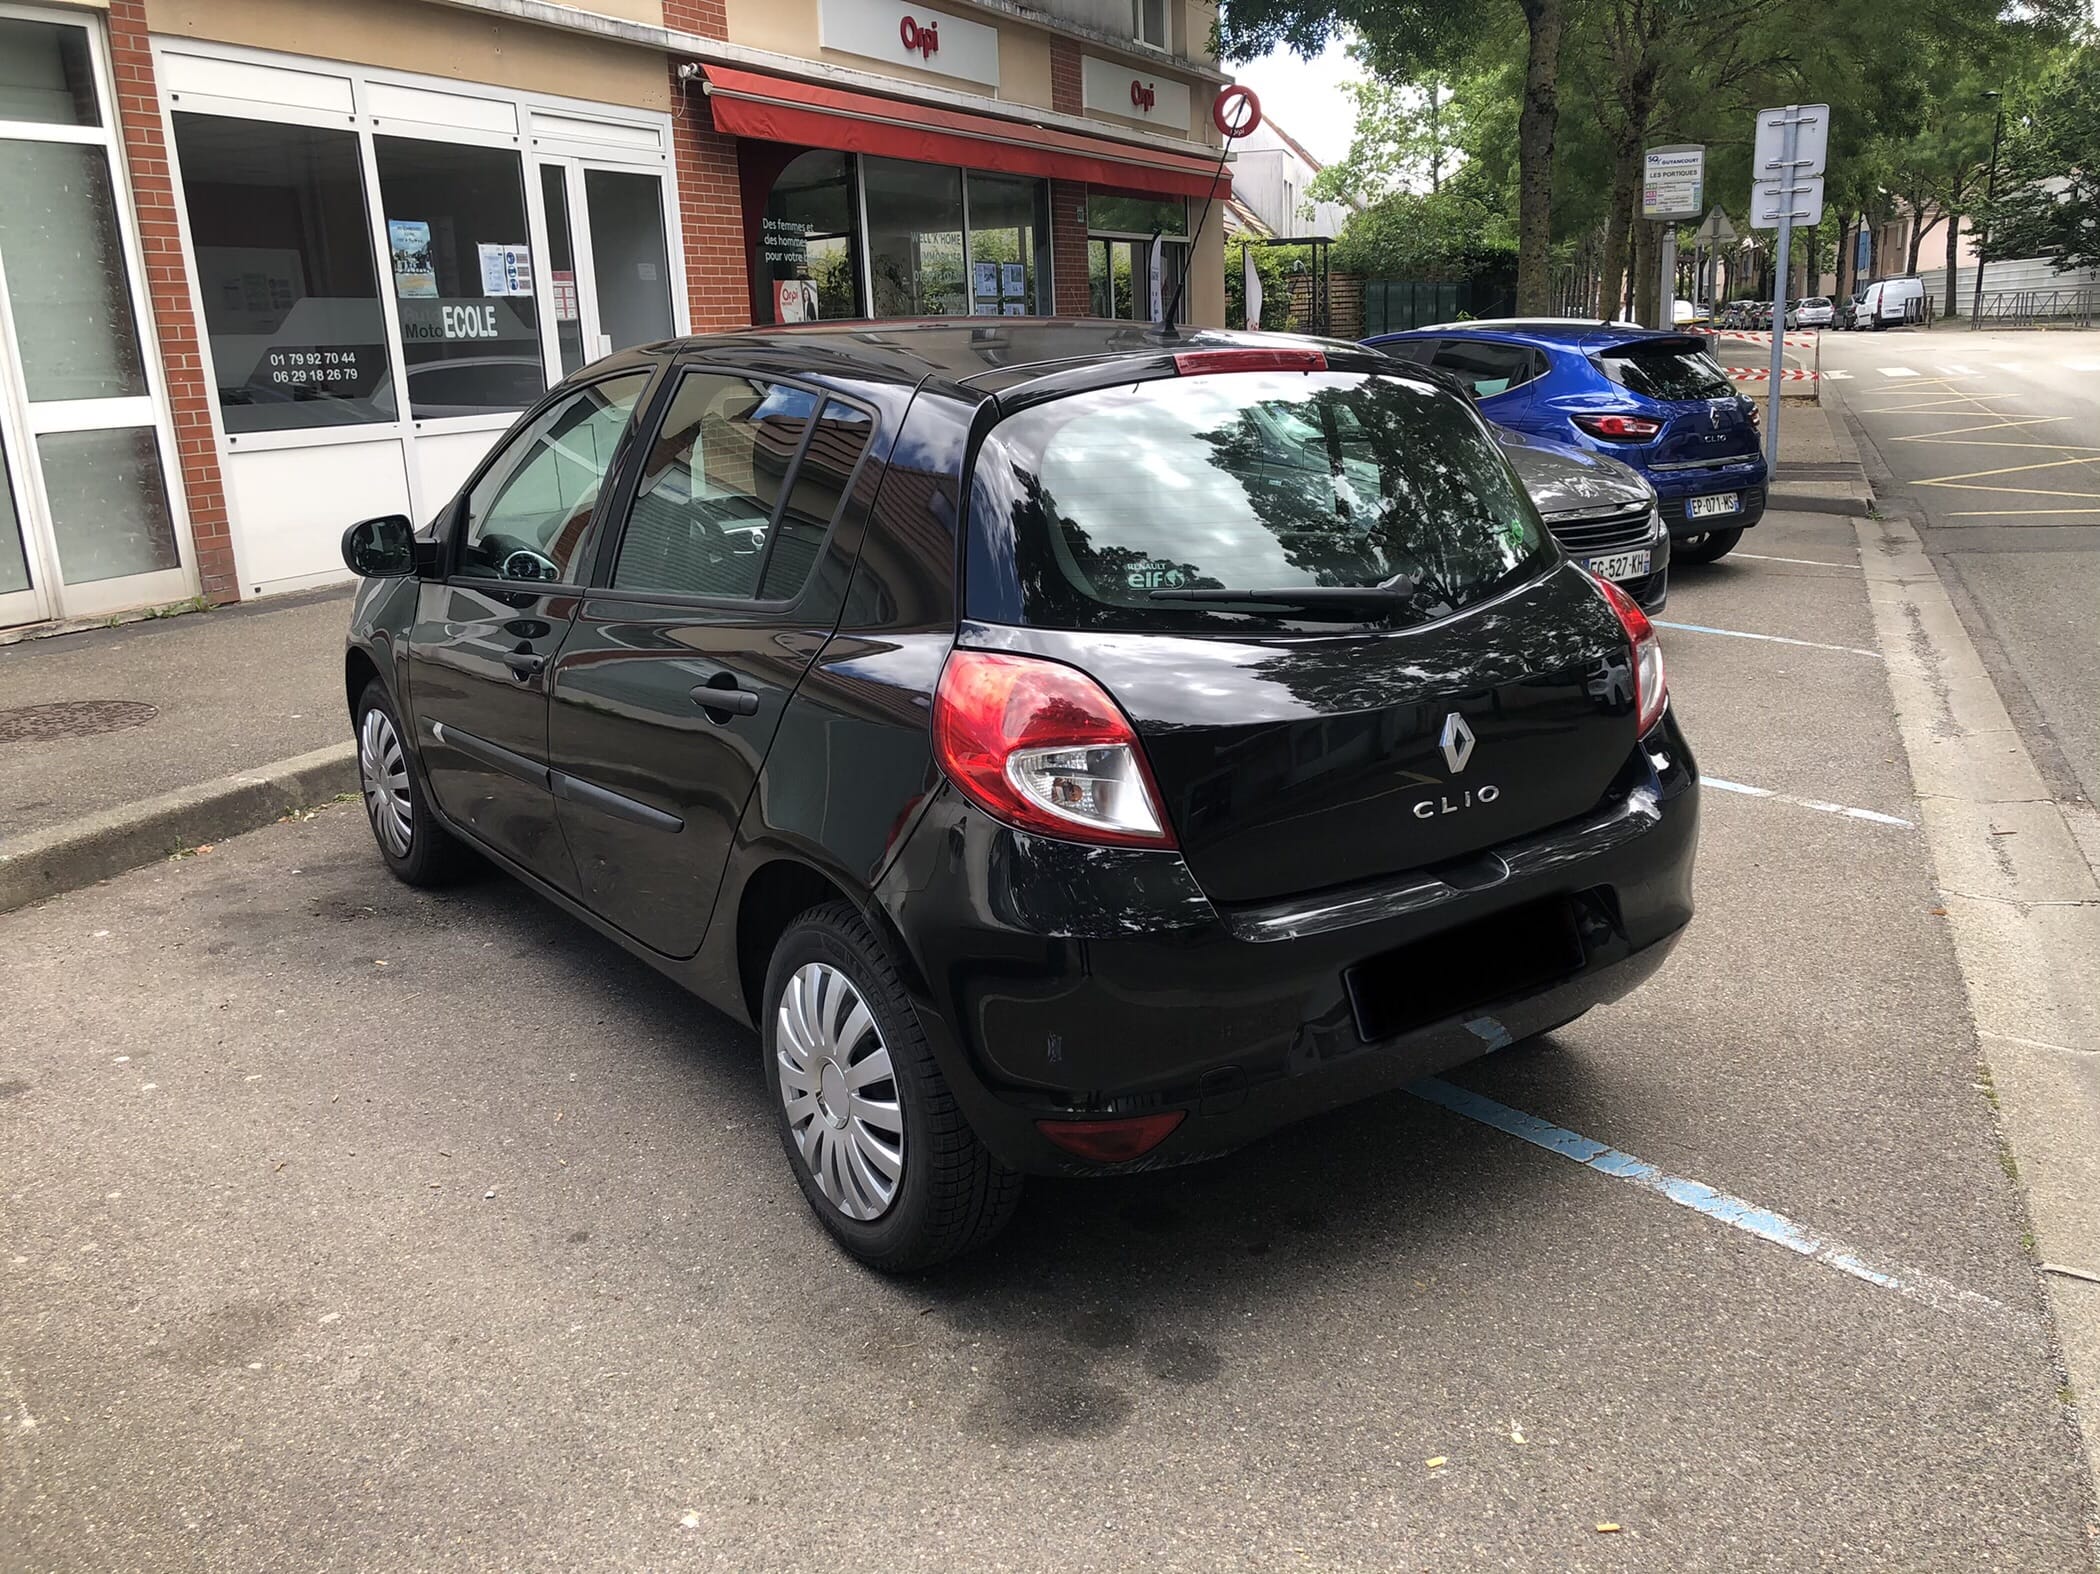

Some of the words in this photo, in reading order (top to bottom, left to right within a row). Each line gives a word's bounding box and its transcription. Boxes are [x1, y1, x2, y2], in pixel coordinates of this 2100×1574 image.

[900, 15, 939, 58] Orpi
[1131, 80, 1154, 112] Orpi
[1661, 157, 1699, 165] GUYANCOURT
[1662, 169, 1698, 177] PORTIQUES
[762, 217, 777, 230] Des
[777, 218, 806, 232] femmes
[764, 233, 777, 246] des
[765, 251, 783, 263] pour
[784, 252, 803, 263] votre
[782, 288, 799, 303] Orpi
[441, 305, 498, 338] ECOLE
[404, 323, 444, 338] Moto
[270, 353, 285, 366] 01
[289, 353, 304, 365] 79
[306, 353, 322, 365] 92
[324, 352, 339, 364] 70
[341, 352, 356, 363] 44
[273, 371, 289, 383] 06
[291, 370, 307, 382] 29
[309, 369, 324, 381] 18
[326, 369, 341, 381] 26
[344, 368, 358, 380] 79
[1704, 434, 1727, 443] CLIO
[1127, 562, 1166, 570] RENAULT
[1128, 571, 1164, 588] elf
[1413, 785, 1500, 819] CLIO
